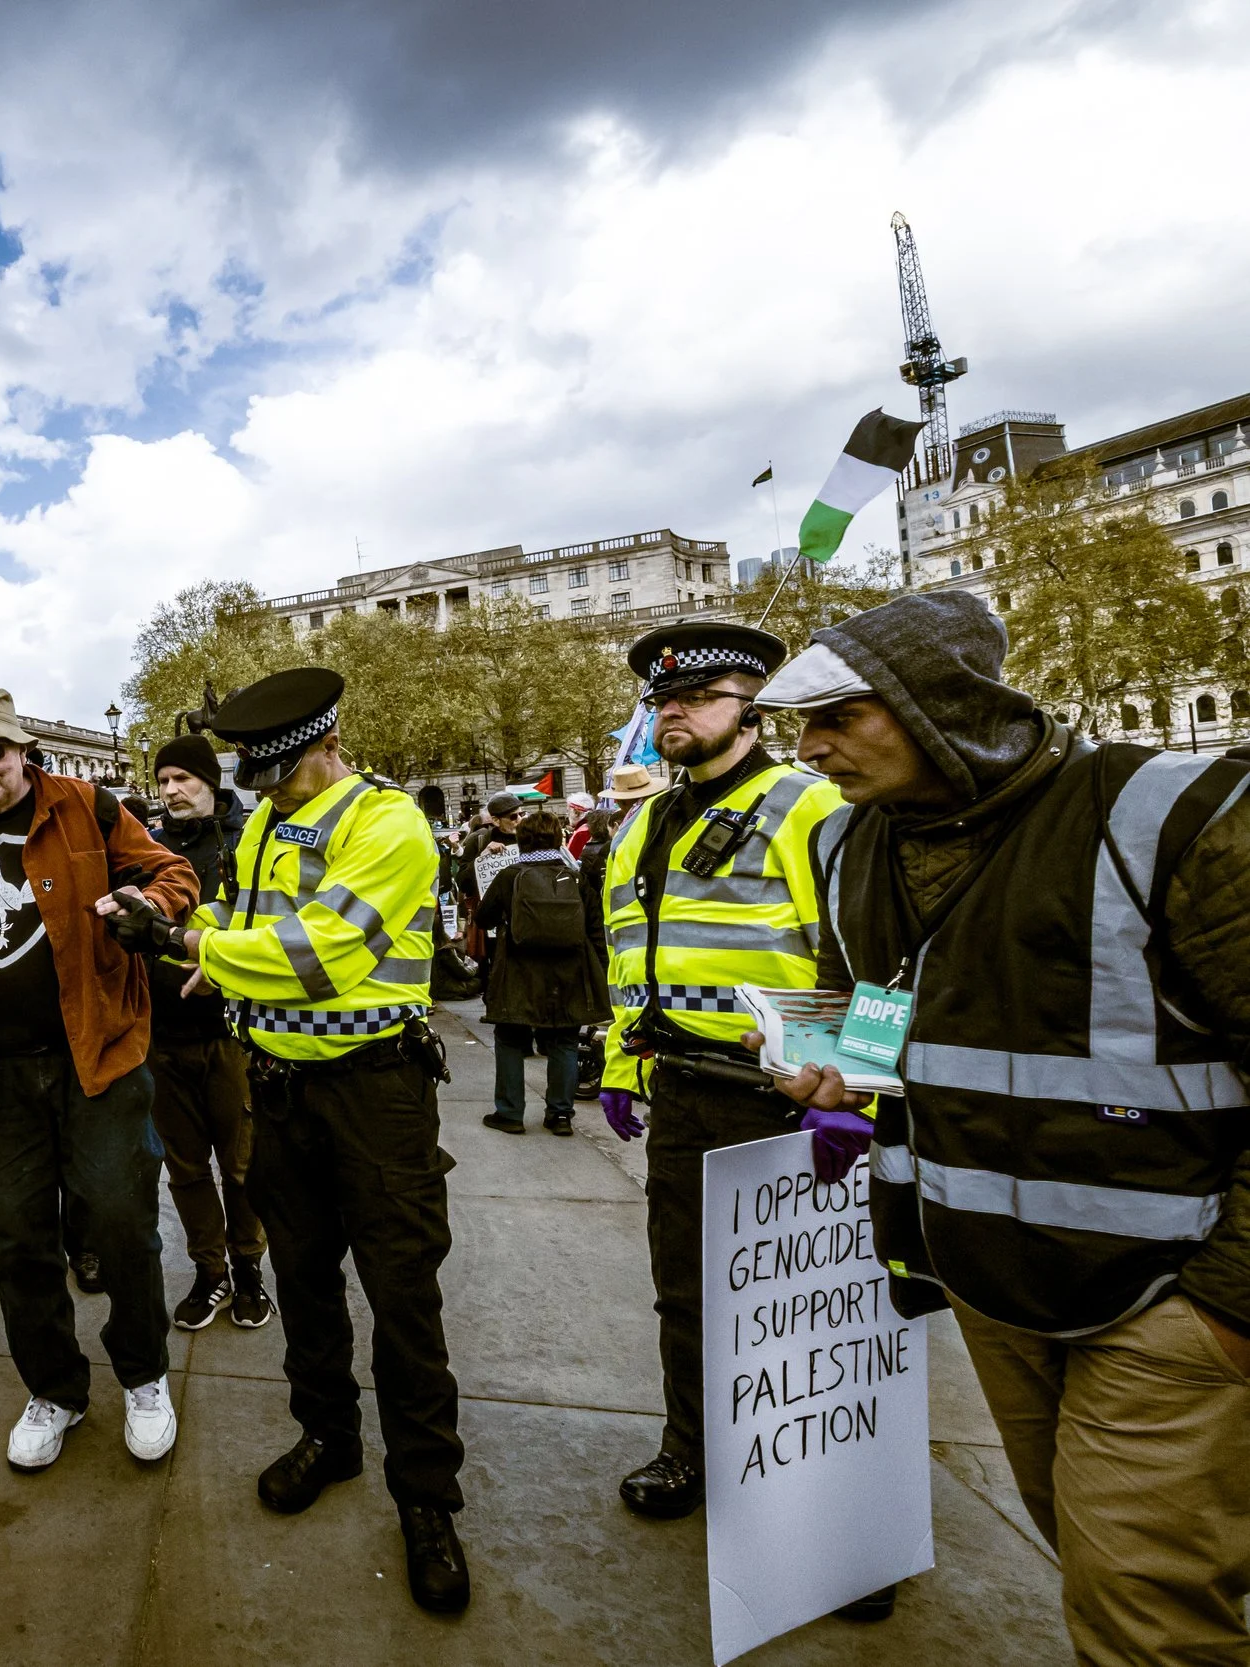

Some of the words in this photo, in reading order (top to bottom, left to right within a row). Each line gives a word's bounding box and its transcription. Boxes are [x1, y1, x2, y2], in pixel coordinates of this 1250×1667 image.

[276, 826, 316, 843] POLICE
[479, 871, 487, 879] IS
[853, 996, 908, 1026] DOPE
[1104, 1106, 1141, 1119] LEO
[733, 1188, 740, 1235] I
[755, 1162, 870, 1226] OPPOSE
[729, 1219, 873, 1292] GENOCIDE
[734, 1314, 740, 1356] I
[751, 1277, 885, 1347] SUPPORT
[732, 1327, 909, 1425] PALESTINE
[741, 1395, 877, 1485] ACTION
